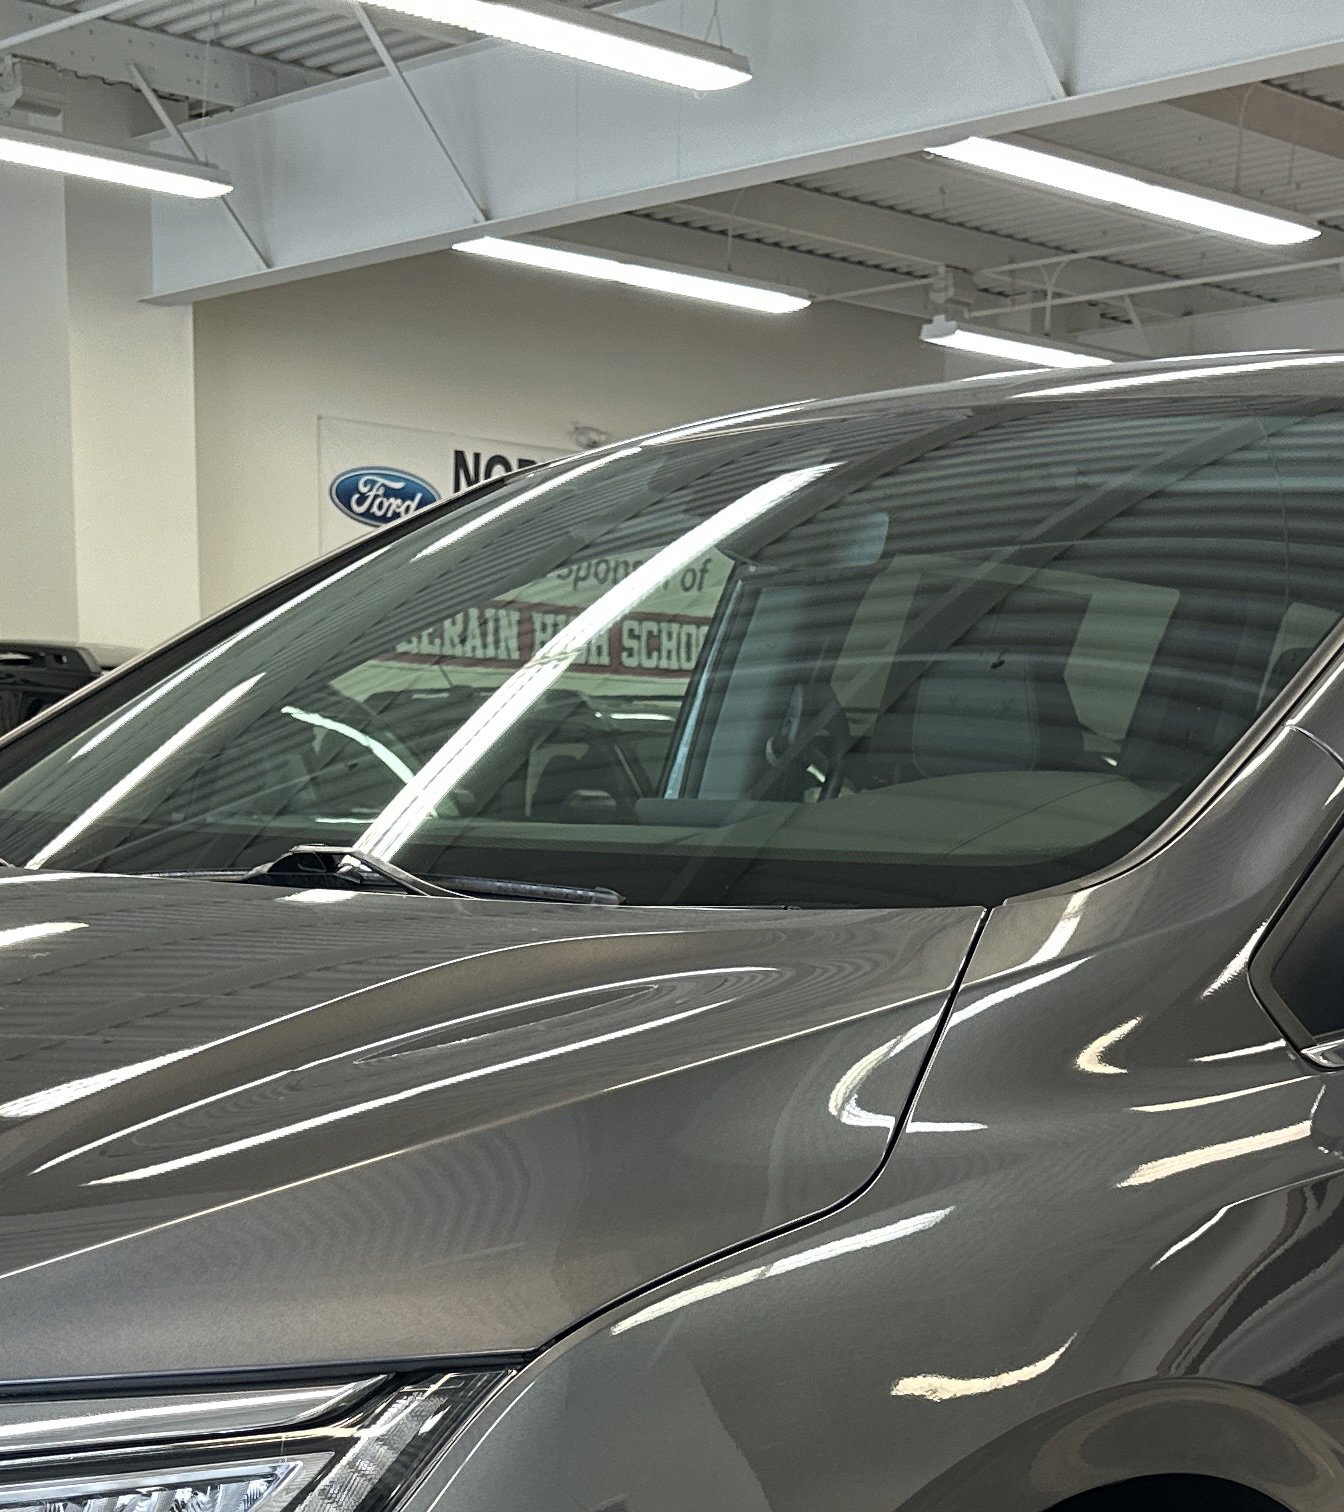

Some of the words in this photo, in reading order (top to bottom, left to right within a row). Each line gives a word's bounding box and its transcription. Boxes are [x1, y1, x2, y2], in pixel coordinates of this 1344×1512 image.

[452, 449, 539, 494] NO
[350, 474, 424, 518] Ford
[681, 557, 713, 593] of
